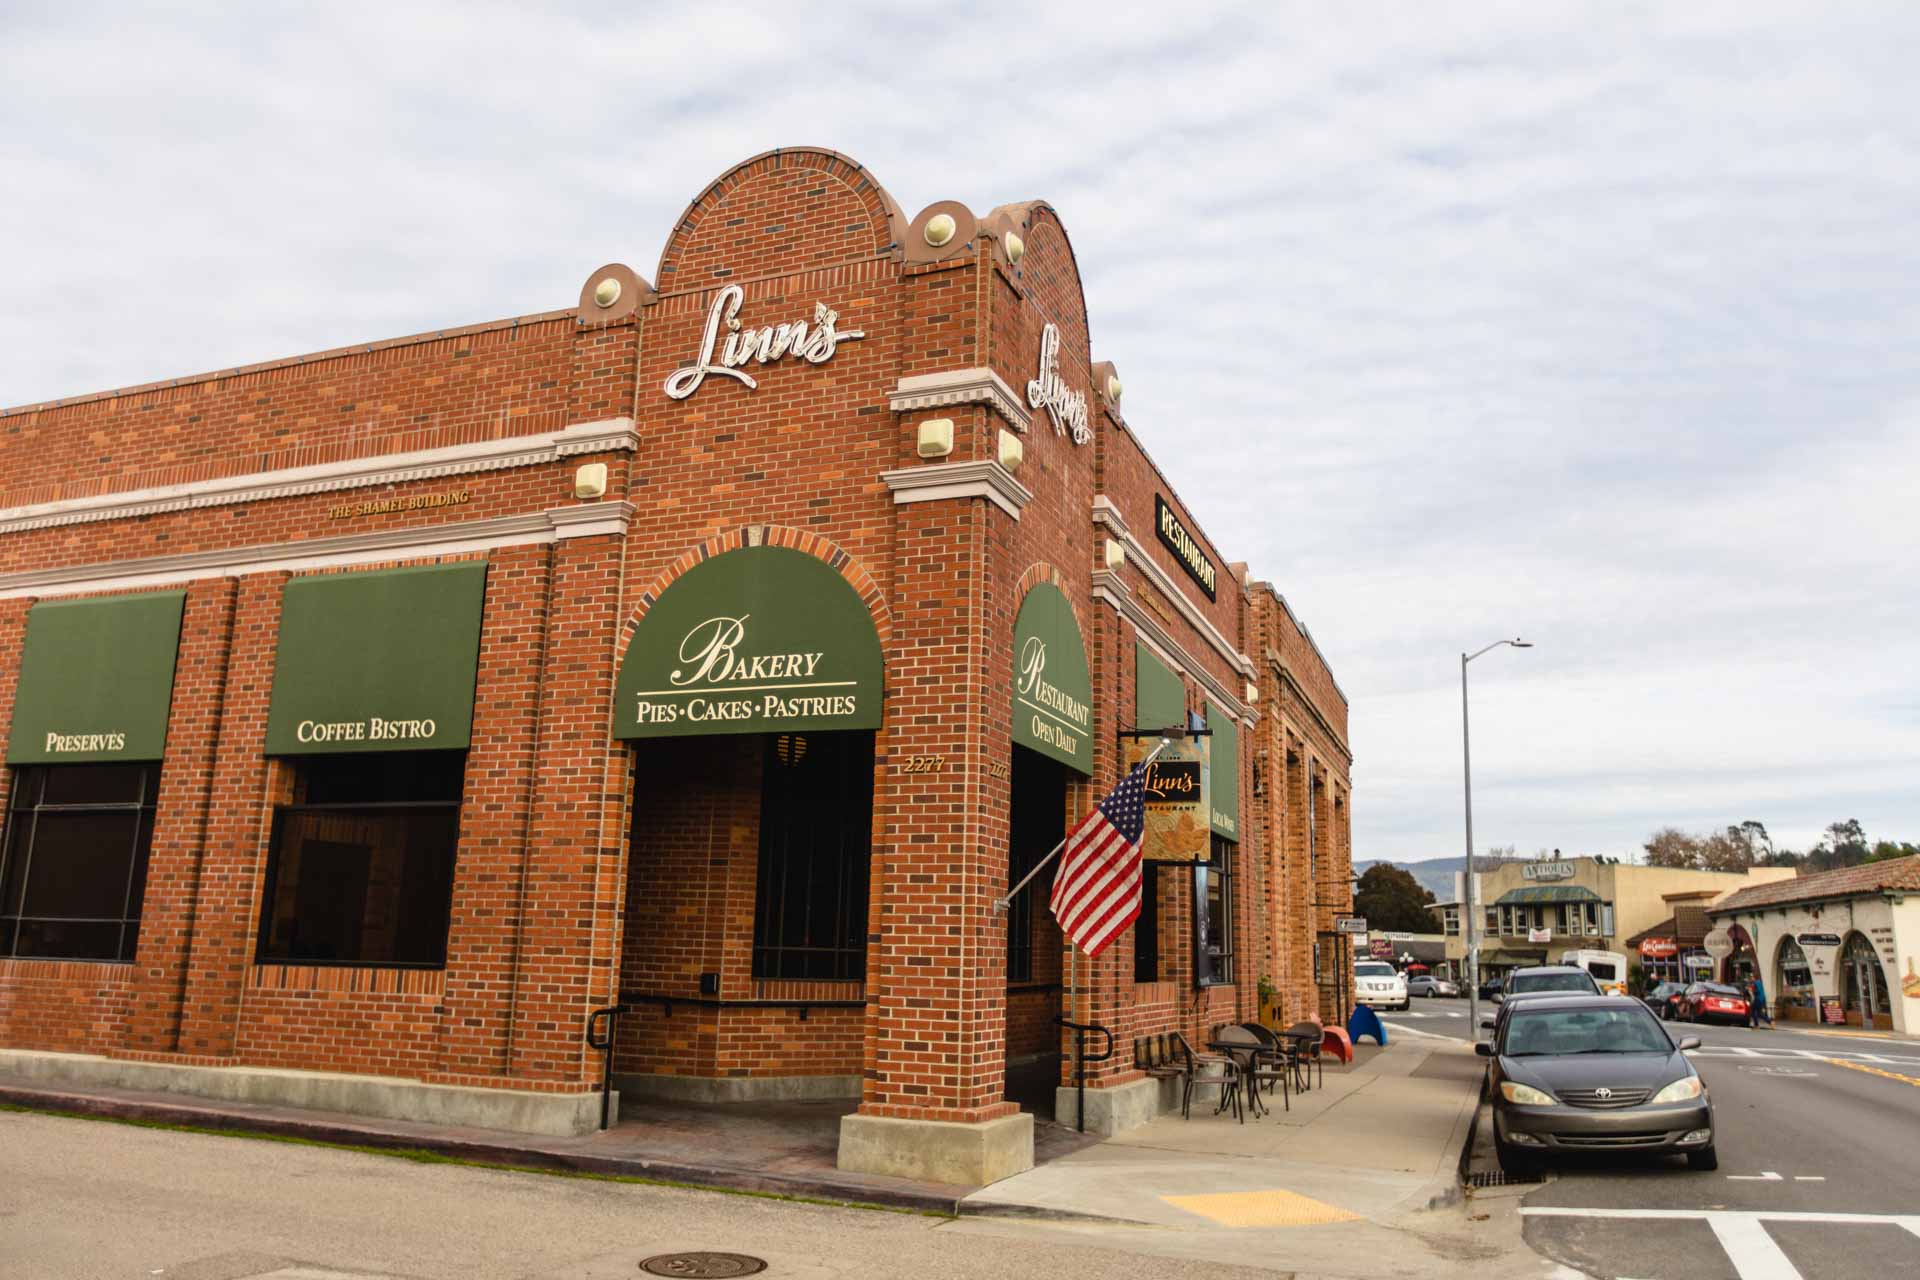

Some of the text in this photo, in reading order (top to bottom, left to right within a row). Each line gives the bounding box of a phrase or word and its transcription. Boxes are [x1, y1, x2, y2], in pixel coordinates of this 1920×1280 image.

[664, 283, 866, 400] Linn's
[328, 491, 470, 519] THE SHAMEL BUILDING
[1161, 504, 1216, 593] RESTAURANT
[670, 614, 824, 686] BAKERY
[1017, 636, 1089, 726] RESTAURANT
[636, 695, 857, 723] PIES CAKES PASTRIES
[45, 731, 126, 753] PRESERVES
[297, 717, 436, 743] COFFEE BISTRO
[1032, 714, 1077, 755] OPEN DAILY
[903, 756, 945, 773] 2277
[1144, 762, 1201, 798] Linn's
[1525, 864, 1572, 876] ANTIQUES
